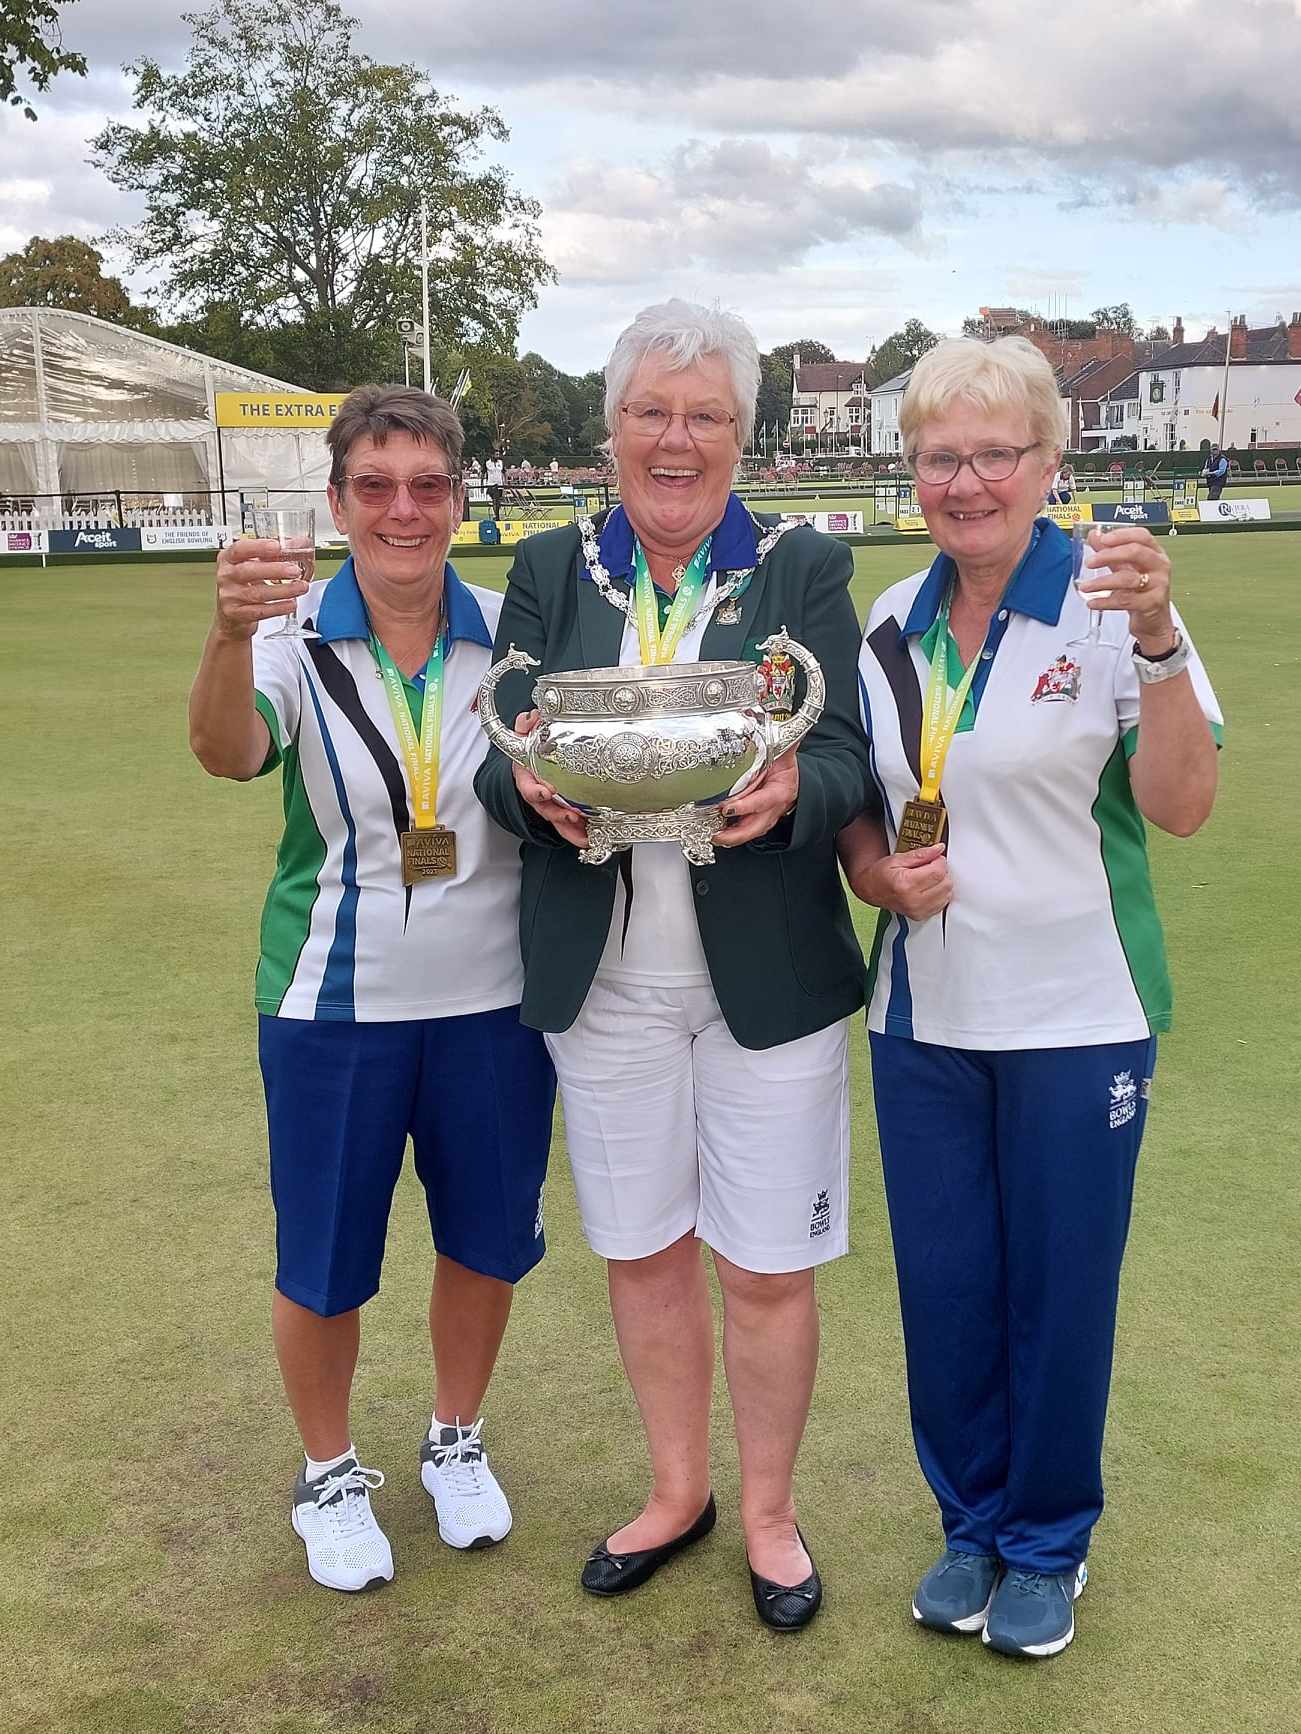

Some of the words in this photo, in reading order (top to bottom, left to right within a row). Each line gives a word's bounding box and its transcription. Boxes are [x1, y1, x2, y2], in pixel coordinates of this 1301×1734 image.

[240, 403, 270, 416] THE
[275, 403, 325, 417] EXTRA
[1047, 505, 1082, 513] NATIONAL
[1047, 512, 1072, 520] FINALS
[1129, 512, 1149, 521] sport
[95, 539, 118, 548] sport
[427, 694, 435, 723] FINALS
[425, 724, 433, 764] NATIONAL
[930, 734, 946, 767] AVIVA
[423, 768, 431, 800] AVIVA
[415, 836, 449, 849] AVIVA
[407, 847, 449, 857] NATIONAL
[407, 856, 438, 866] FINALS
